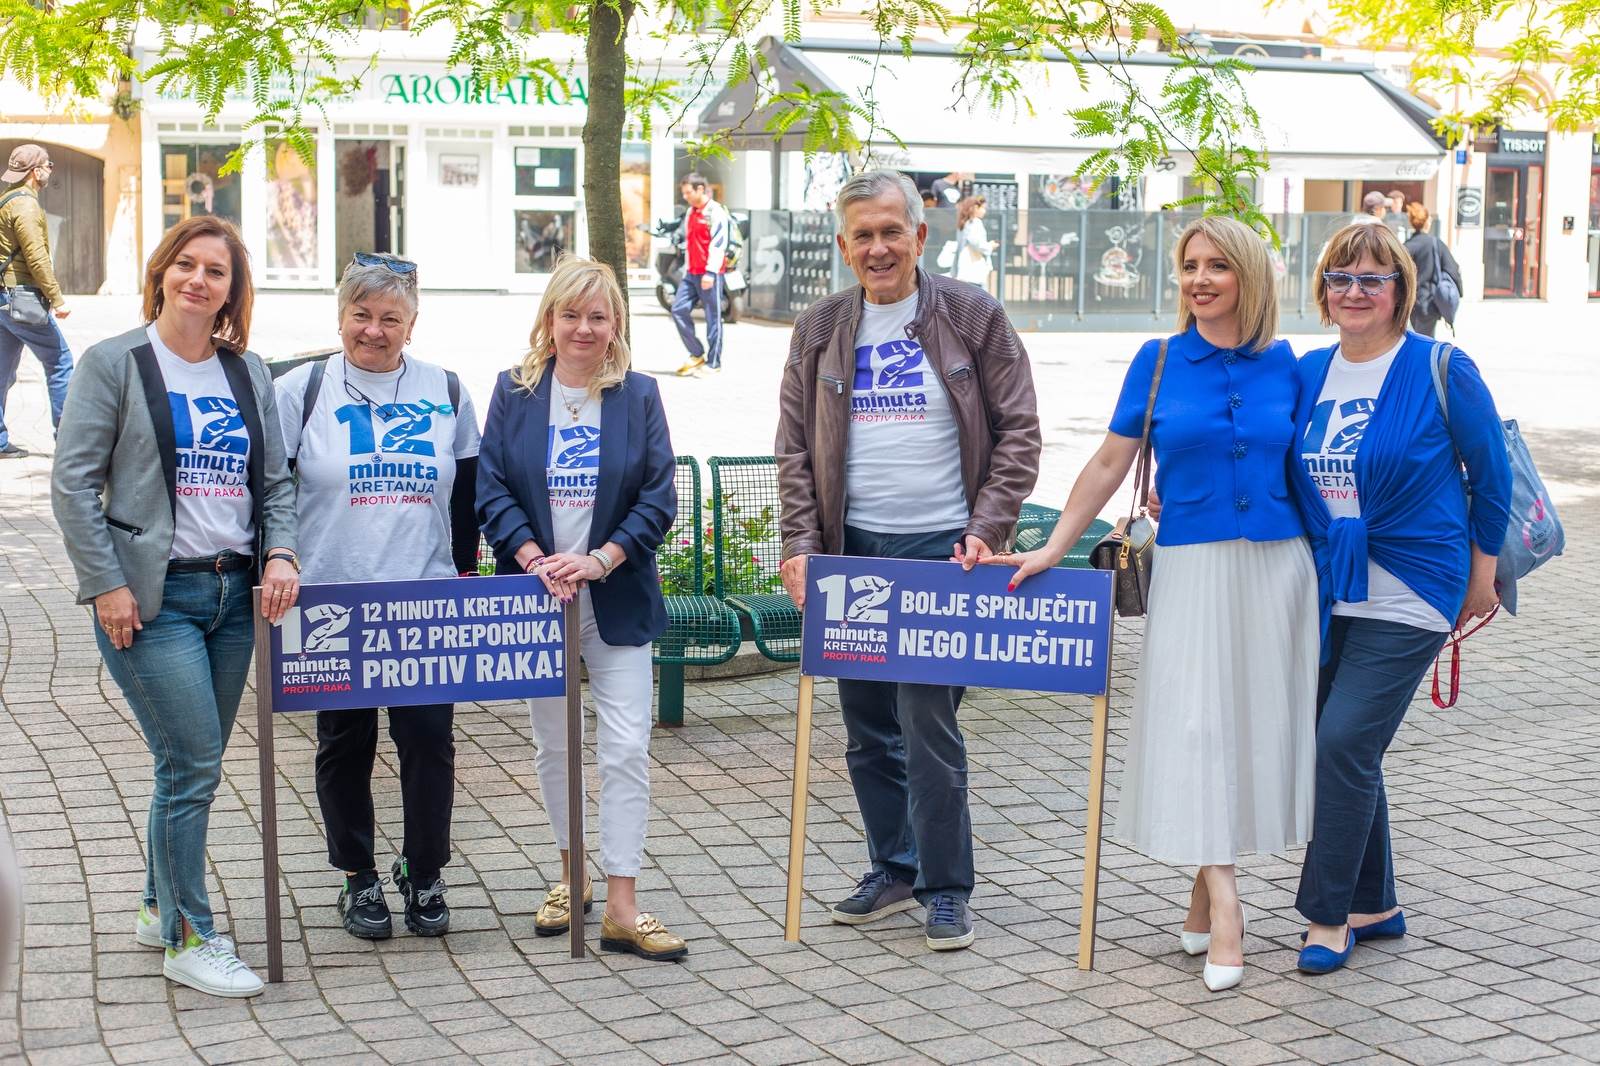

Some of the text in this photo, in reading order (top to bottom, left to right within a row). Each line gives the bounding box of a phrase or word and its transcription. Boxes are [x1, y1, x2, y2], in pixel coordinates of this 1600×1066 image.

[1503, 138, 1546, 153] TISSOT
[853, 340, 924, 391] 12
[852, 391, 927, 409] minuta
[167, 391, 248, 456] 12
[852, 414, 925, 423] PROTIV RAKA
[334, 402, 436, 457] 12
[349, 461, 438, 481] minuta
[1302, 455, 1354, 474] minu
[178, 471, 245, 487] RETANJA
[350, 481, 435, 494] KRETANJA
[547, 471, 599, 488] inuta
[1310, 475, 1355, 487] RETA
[175, 486, 245, 497] ROTIV RAKA
[549, 489, 598, 498] ETANJA
[1320, 489, 1349, 500] OTIV
[350, 495, 432, 507] PROTIV RAKA
[550, 499, 566, 508] TIV
[362, 593, 562, 622] 12 MINUTA KRETANJA
[816, 574, 893, 624] 12
[901, 590, 1097, 625] BOLJE SPRIJEČITI
[272, 602, 352, 655] 12
[362, 620, 563, 653] ZA 12 PREPORUKA
[824, 624, 888, 643] minuta
[823, 640, 887, 654] KRETANJA
[899, 628, 1094, 667] NEGO LIJEČITI!
[282, 654, 351, 675] minuta
[823, 652, 887, 664] PROTIV RAKA
[282, 671, 351, 685] KRETANJA
[363, 650, 564, 689] PROTIV RAKA!
[282, 683, 352, 695] PROTIV RAKA
